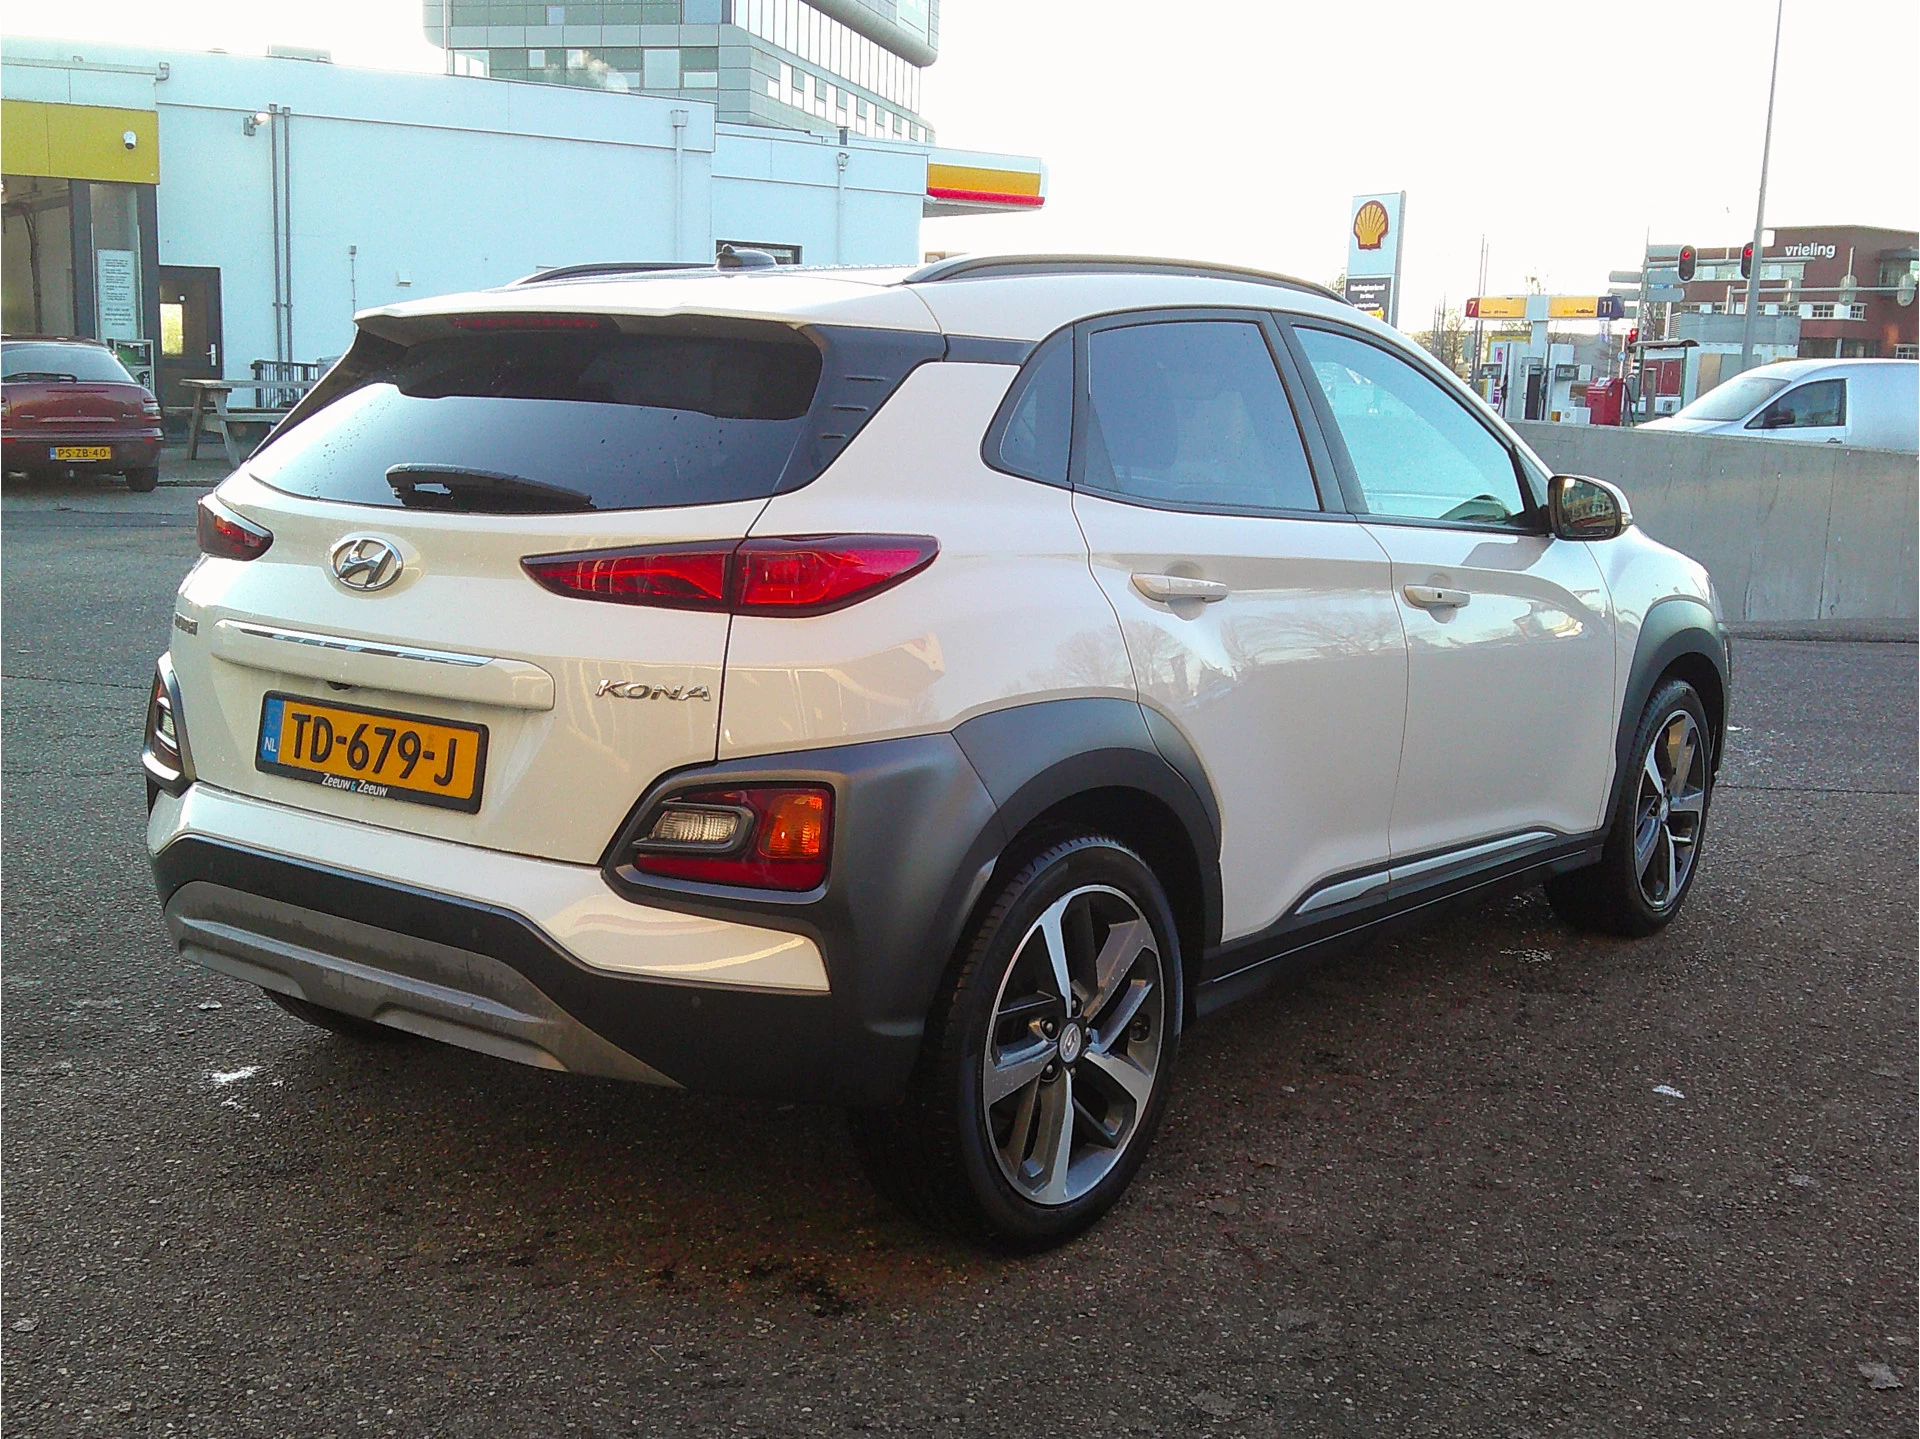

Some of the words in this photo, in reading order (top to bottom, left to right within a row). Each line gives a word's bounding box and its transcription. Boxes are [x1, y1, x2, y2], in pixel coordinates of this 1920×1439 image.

[1785, 242, 1836, 259] vrieling
[1467, 300, 1476, 315] 7
[1601, 301, 1613, 314] 11
[595, 679, 712, 702] KONA
[264, 736, 277, 753] NL
[291, 712, 458, 787] TD-679-J
[322, 773, 350, 790] Zeeuw
[351, 781, 356, 791] &
[357, 780, 389, 797] Zeeuw
